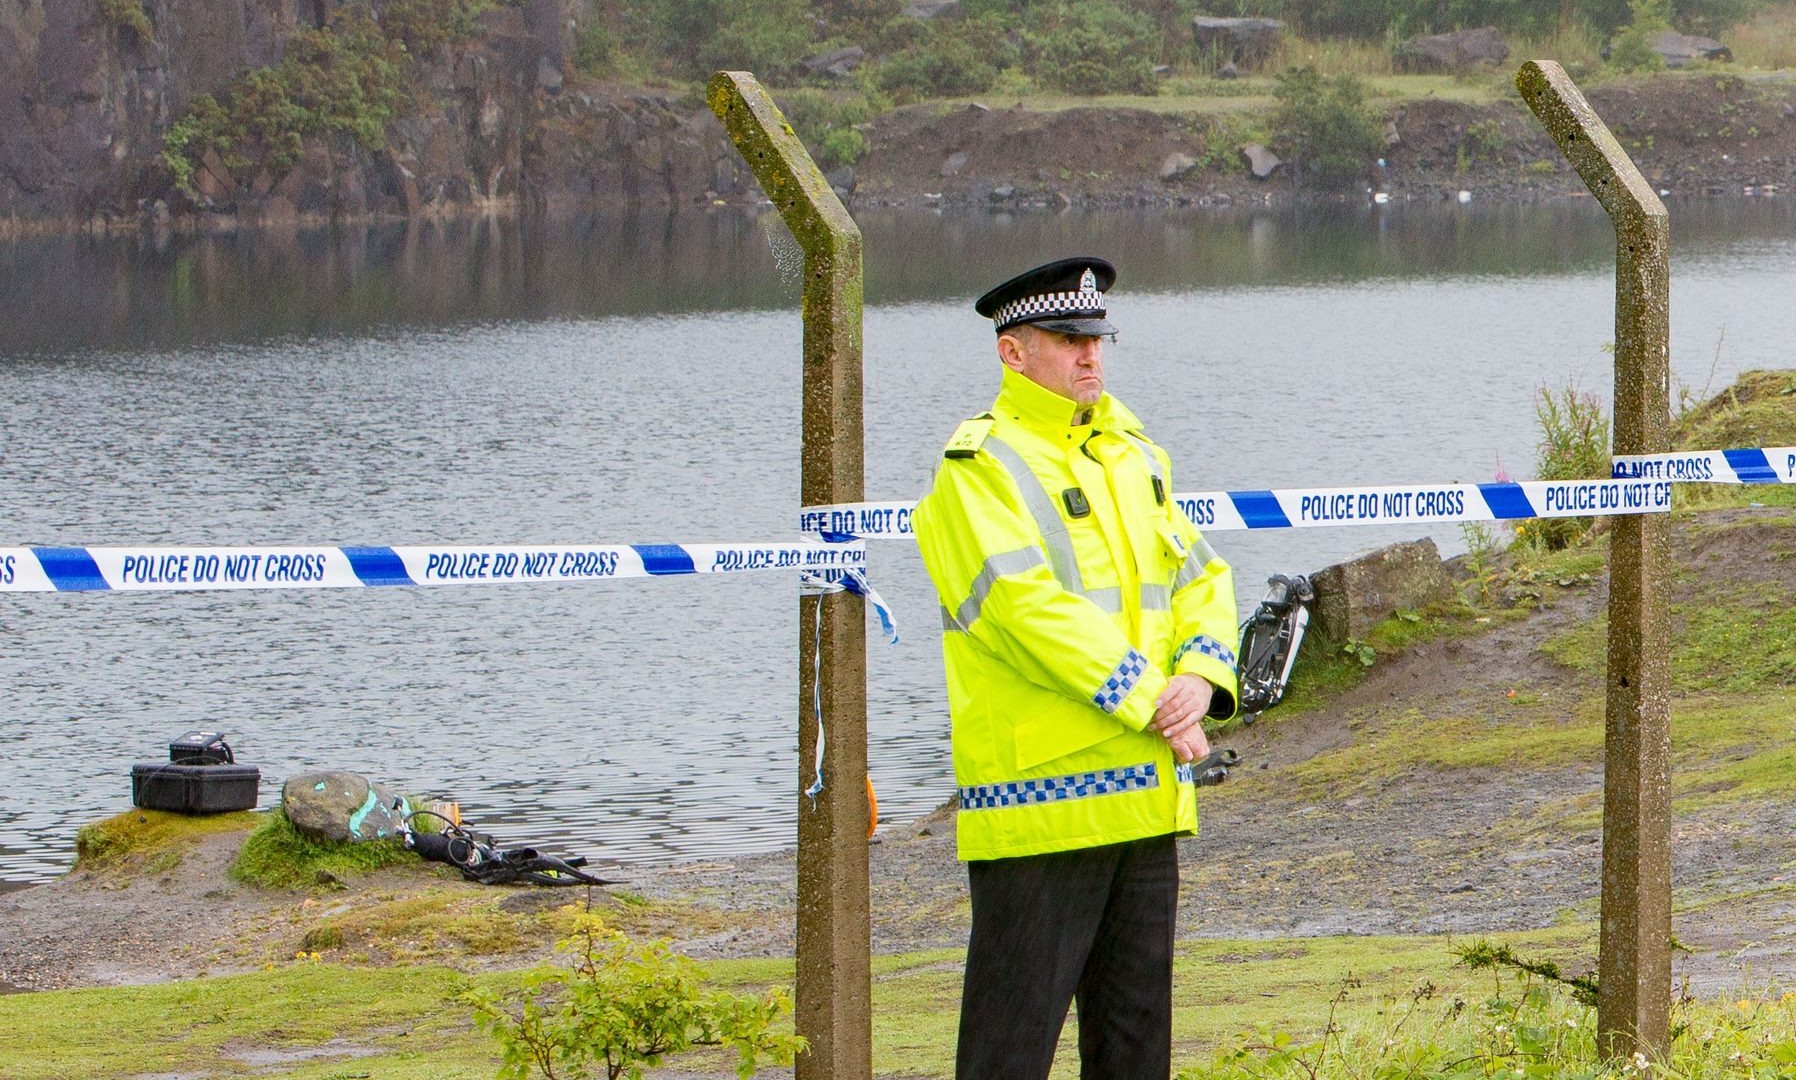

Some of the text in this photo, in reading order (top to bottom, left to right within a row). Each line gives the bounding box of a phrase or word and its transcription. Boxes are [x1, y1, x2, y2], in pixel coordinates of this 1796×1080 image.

[1631, 461, 1662, 478] NOT
[1666, 457, 1713, 480] CROSS
[1301, 490, 1464, 520] POLICE DO NOT CROSS
[1546, 486, 1596, 511] POLICE
[1600, 484, 1619, 509] DO
[1623, 483, 1651, 508] NOT
[800, 512, 827, 532] ICE
[831, 511, 855, 533] DO
[861, 509, 893, 533] NOT
[1176, 499, 1214, 525] OSS
[122, 554, 326, 584] POLICE DO NOT CROSS
[426, 551, 619, 579] POLICE DO NOT CROSS
[712, 550, 774, 571] POLICE
[774, 550, 801, 567] DO
[803, 549, 839, 565] NOT
